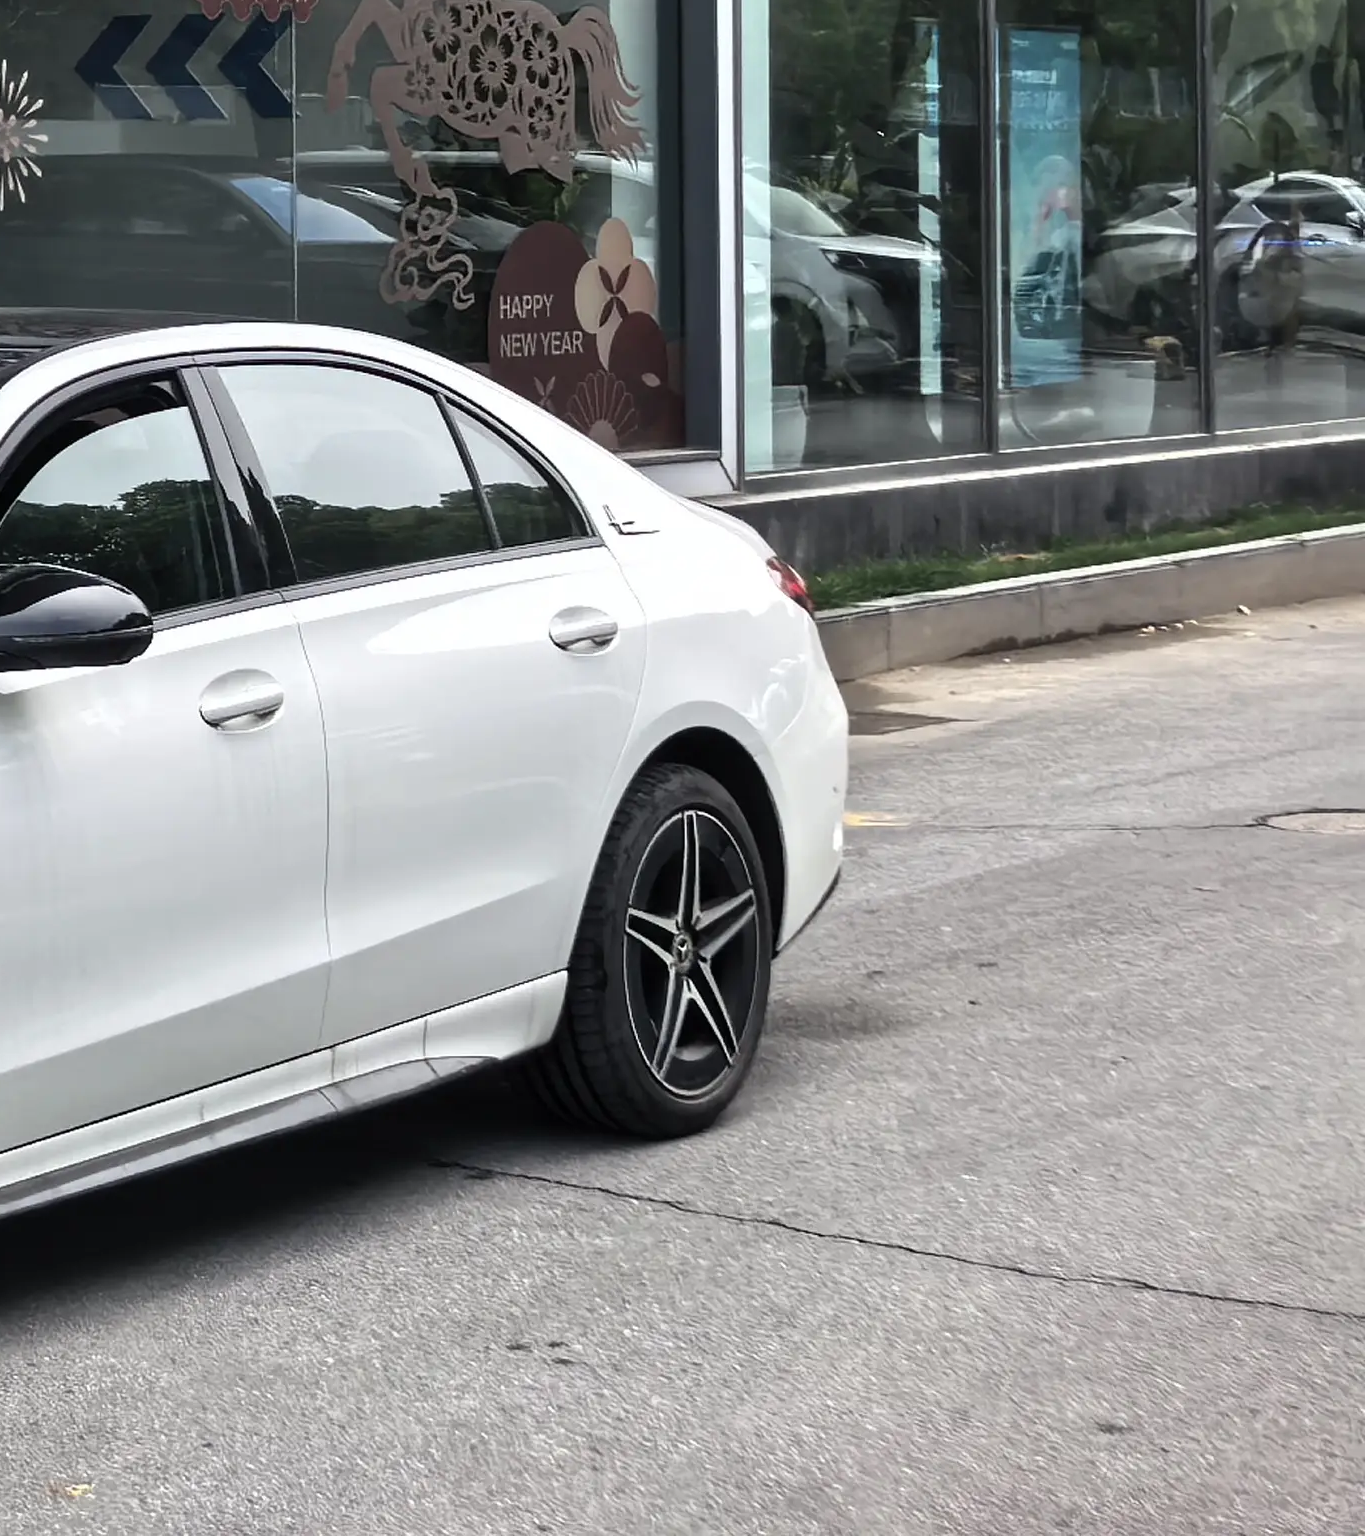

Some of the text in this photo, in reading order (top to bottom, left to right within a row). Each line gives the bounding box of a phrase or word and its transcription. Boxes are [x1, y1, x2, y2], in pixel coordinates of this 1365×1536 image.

[499, 293, 554, 319] HAPPY
[499, 330, 584, 358] NEW YEAR
